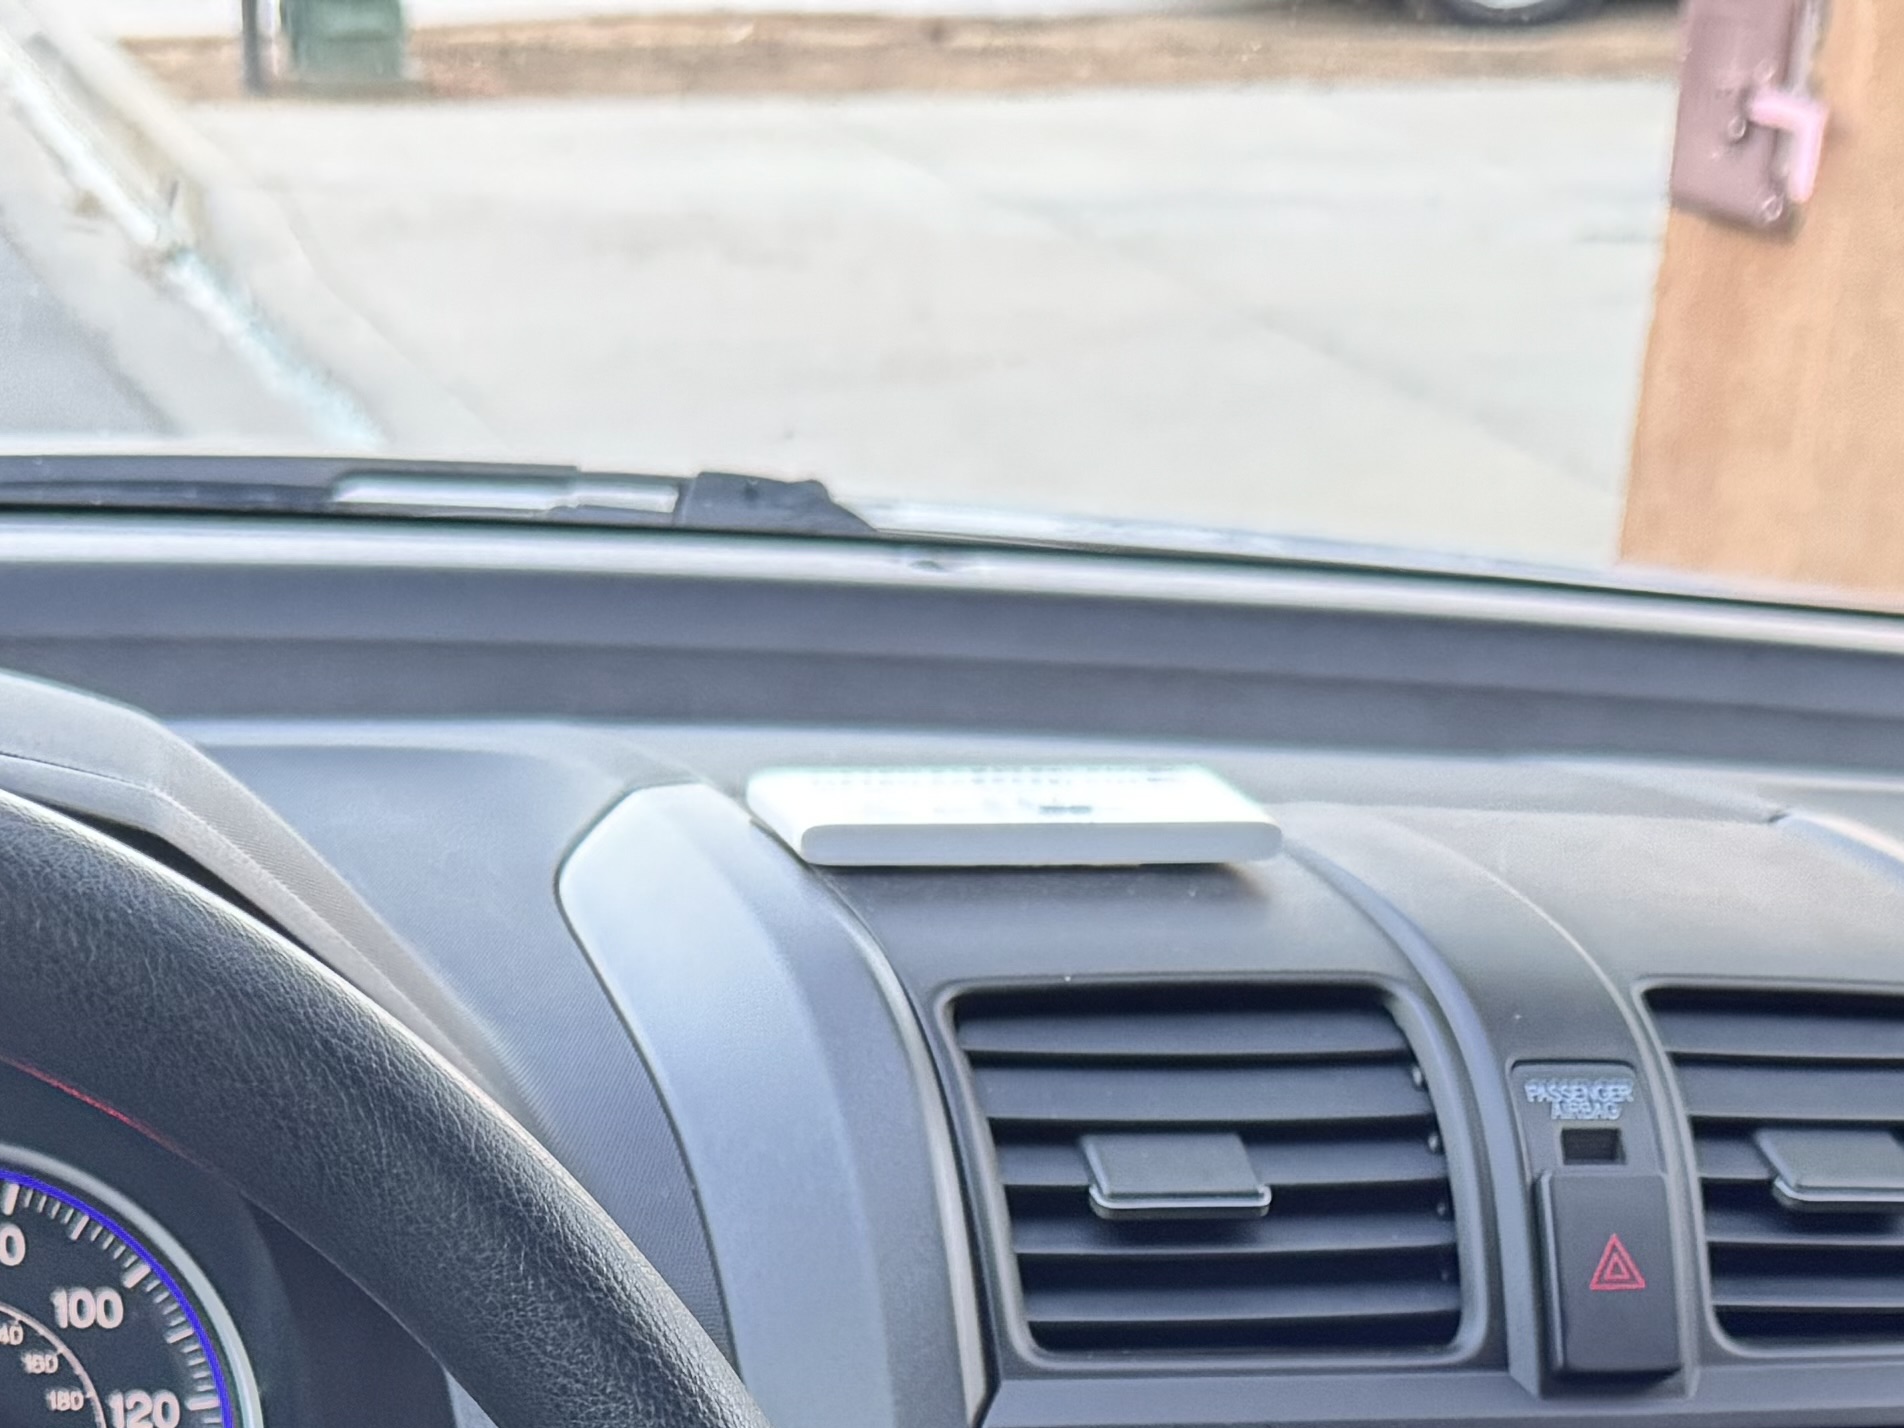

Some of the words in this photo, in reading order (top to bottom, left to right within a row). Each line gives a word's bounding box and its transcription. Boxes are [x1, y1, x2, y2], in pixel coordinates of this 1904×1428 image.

[1524, 1078, 1634, 1103] PASSENGER
[1550, 1101, 1623, 1120] AIRBAG
[51, 1287, 124, 1329] 100
[21, 1352, 59, 1375] 160
[46, 1387, 84, 1412] 180
